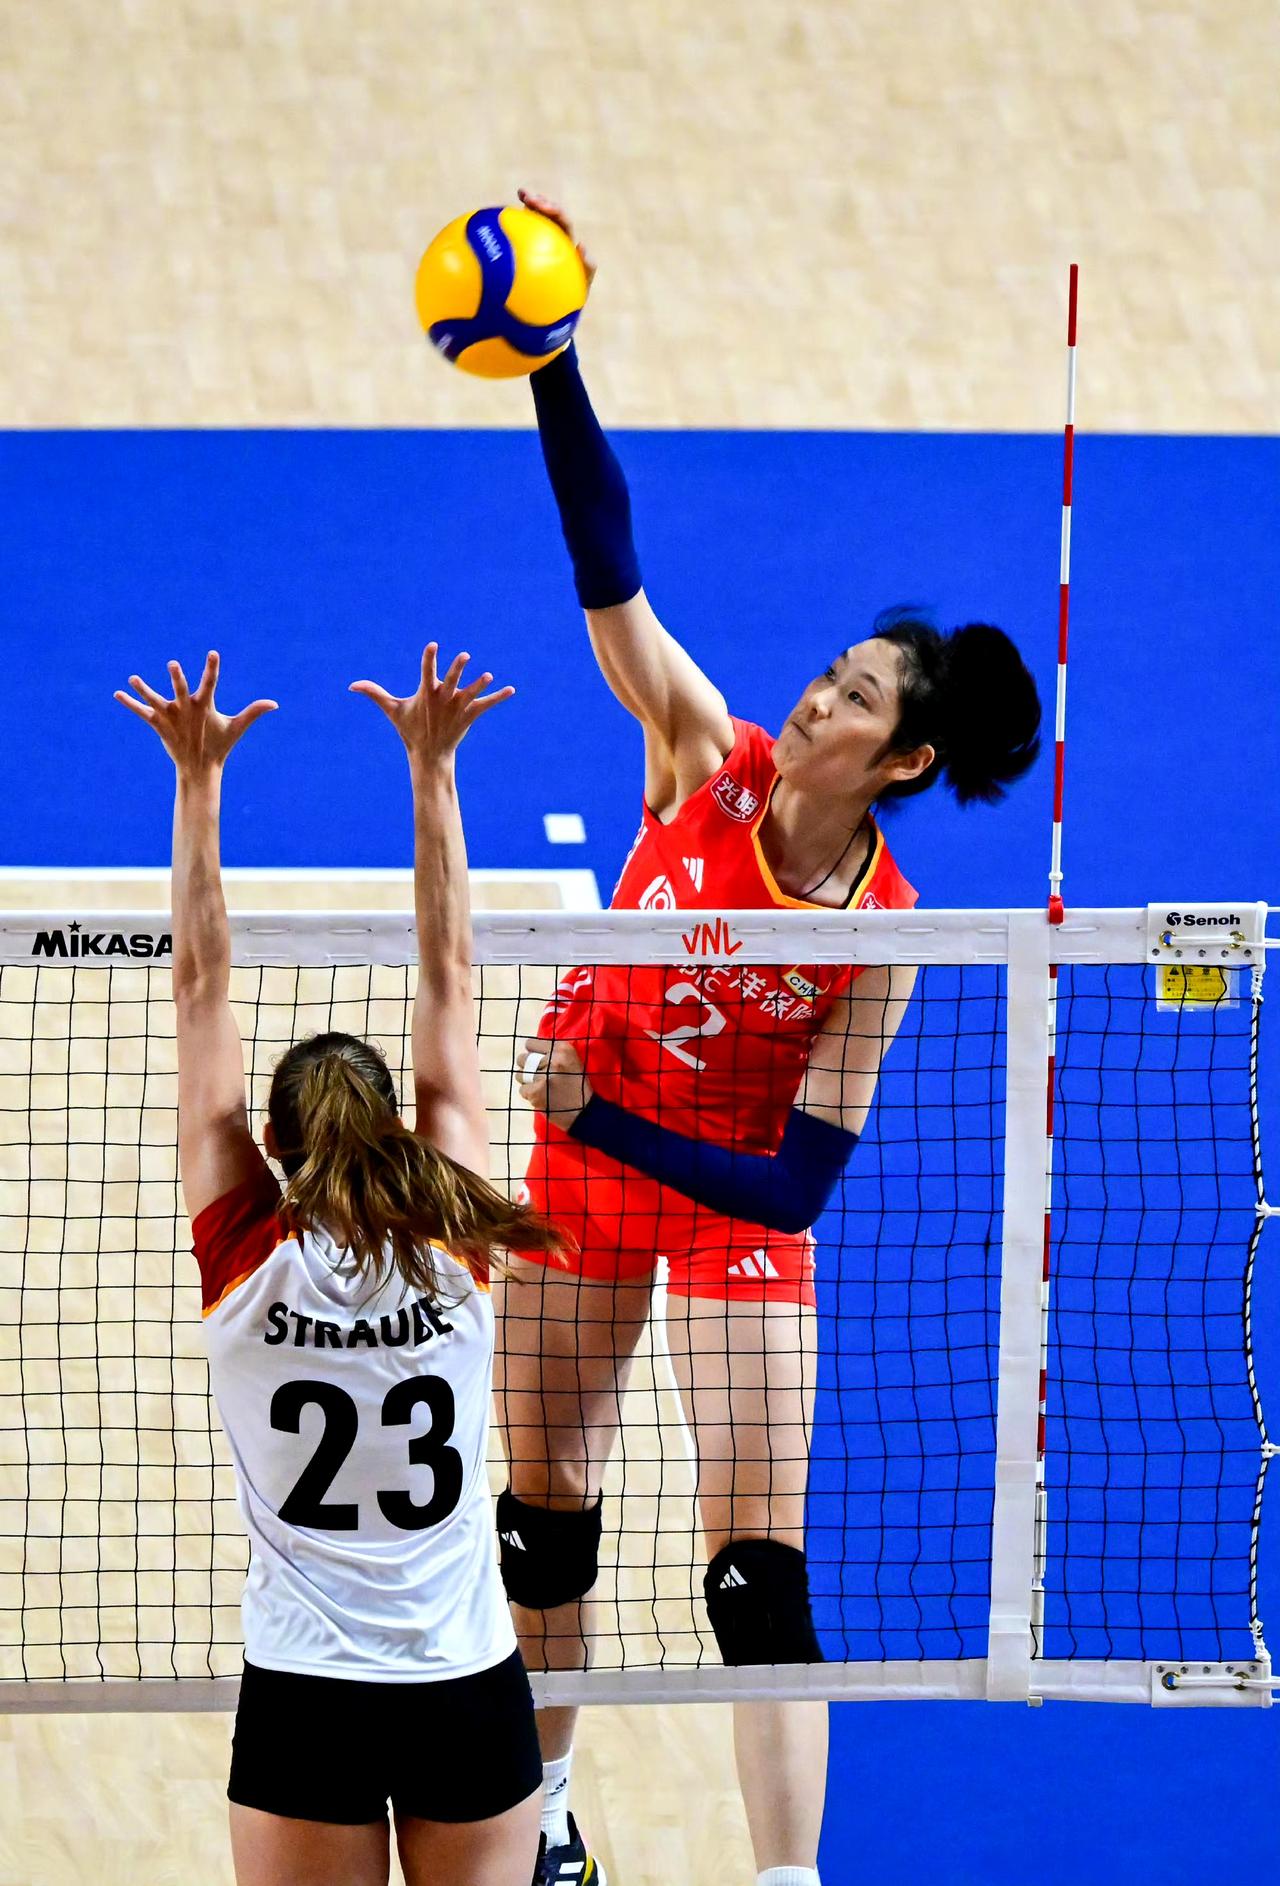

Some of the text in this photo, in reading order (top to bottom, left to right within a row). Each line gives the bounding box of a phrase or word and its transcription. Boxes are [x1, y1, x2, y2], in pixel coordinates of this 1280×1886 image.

[681, 917, 743, 956] VNL
[1183, 914, 1240, 926] Senoh
[642, 981, 727, 1073] 2
[269, 1374, 464, 1531] 23
